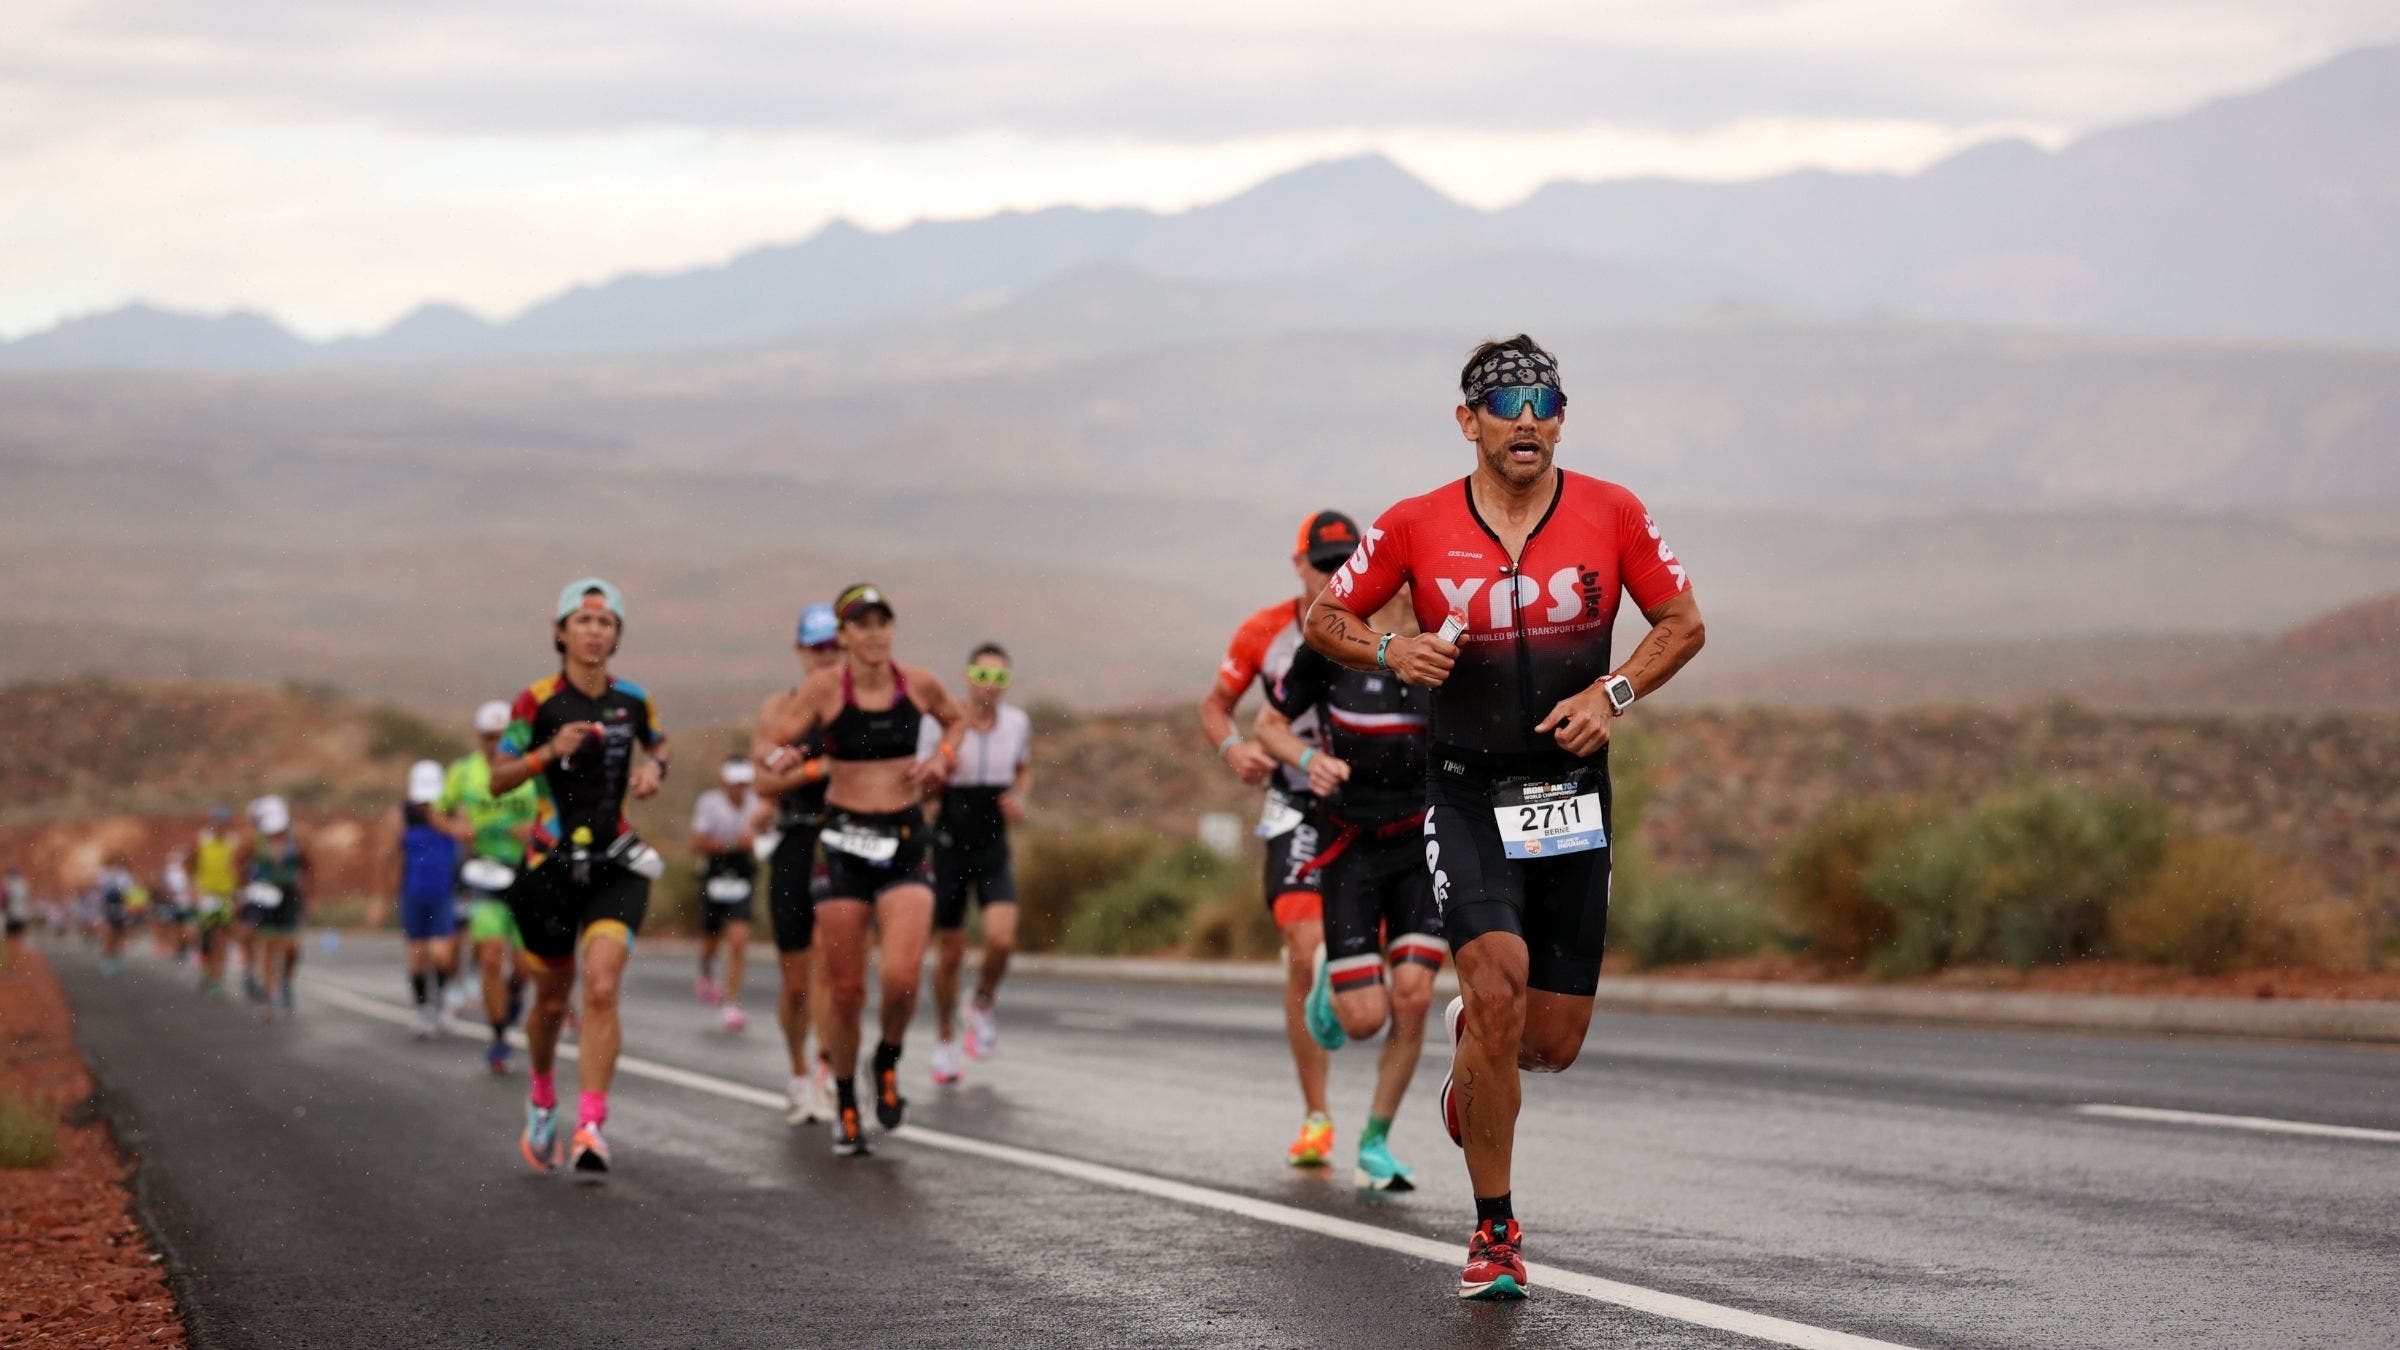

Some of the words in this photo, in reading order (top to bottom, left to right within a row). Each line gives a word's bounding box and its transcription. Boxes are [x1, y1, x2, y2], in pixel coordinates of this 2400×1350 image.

[1435, 566, 1582, 630] YPS
[1527, 623, 1575, 637] TRANSPORT
[1562, 781, 1578, 791] 70.3
[1519, 799, 1581, 832] 2711
